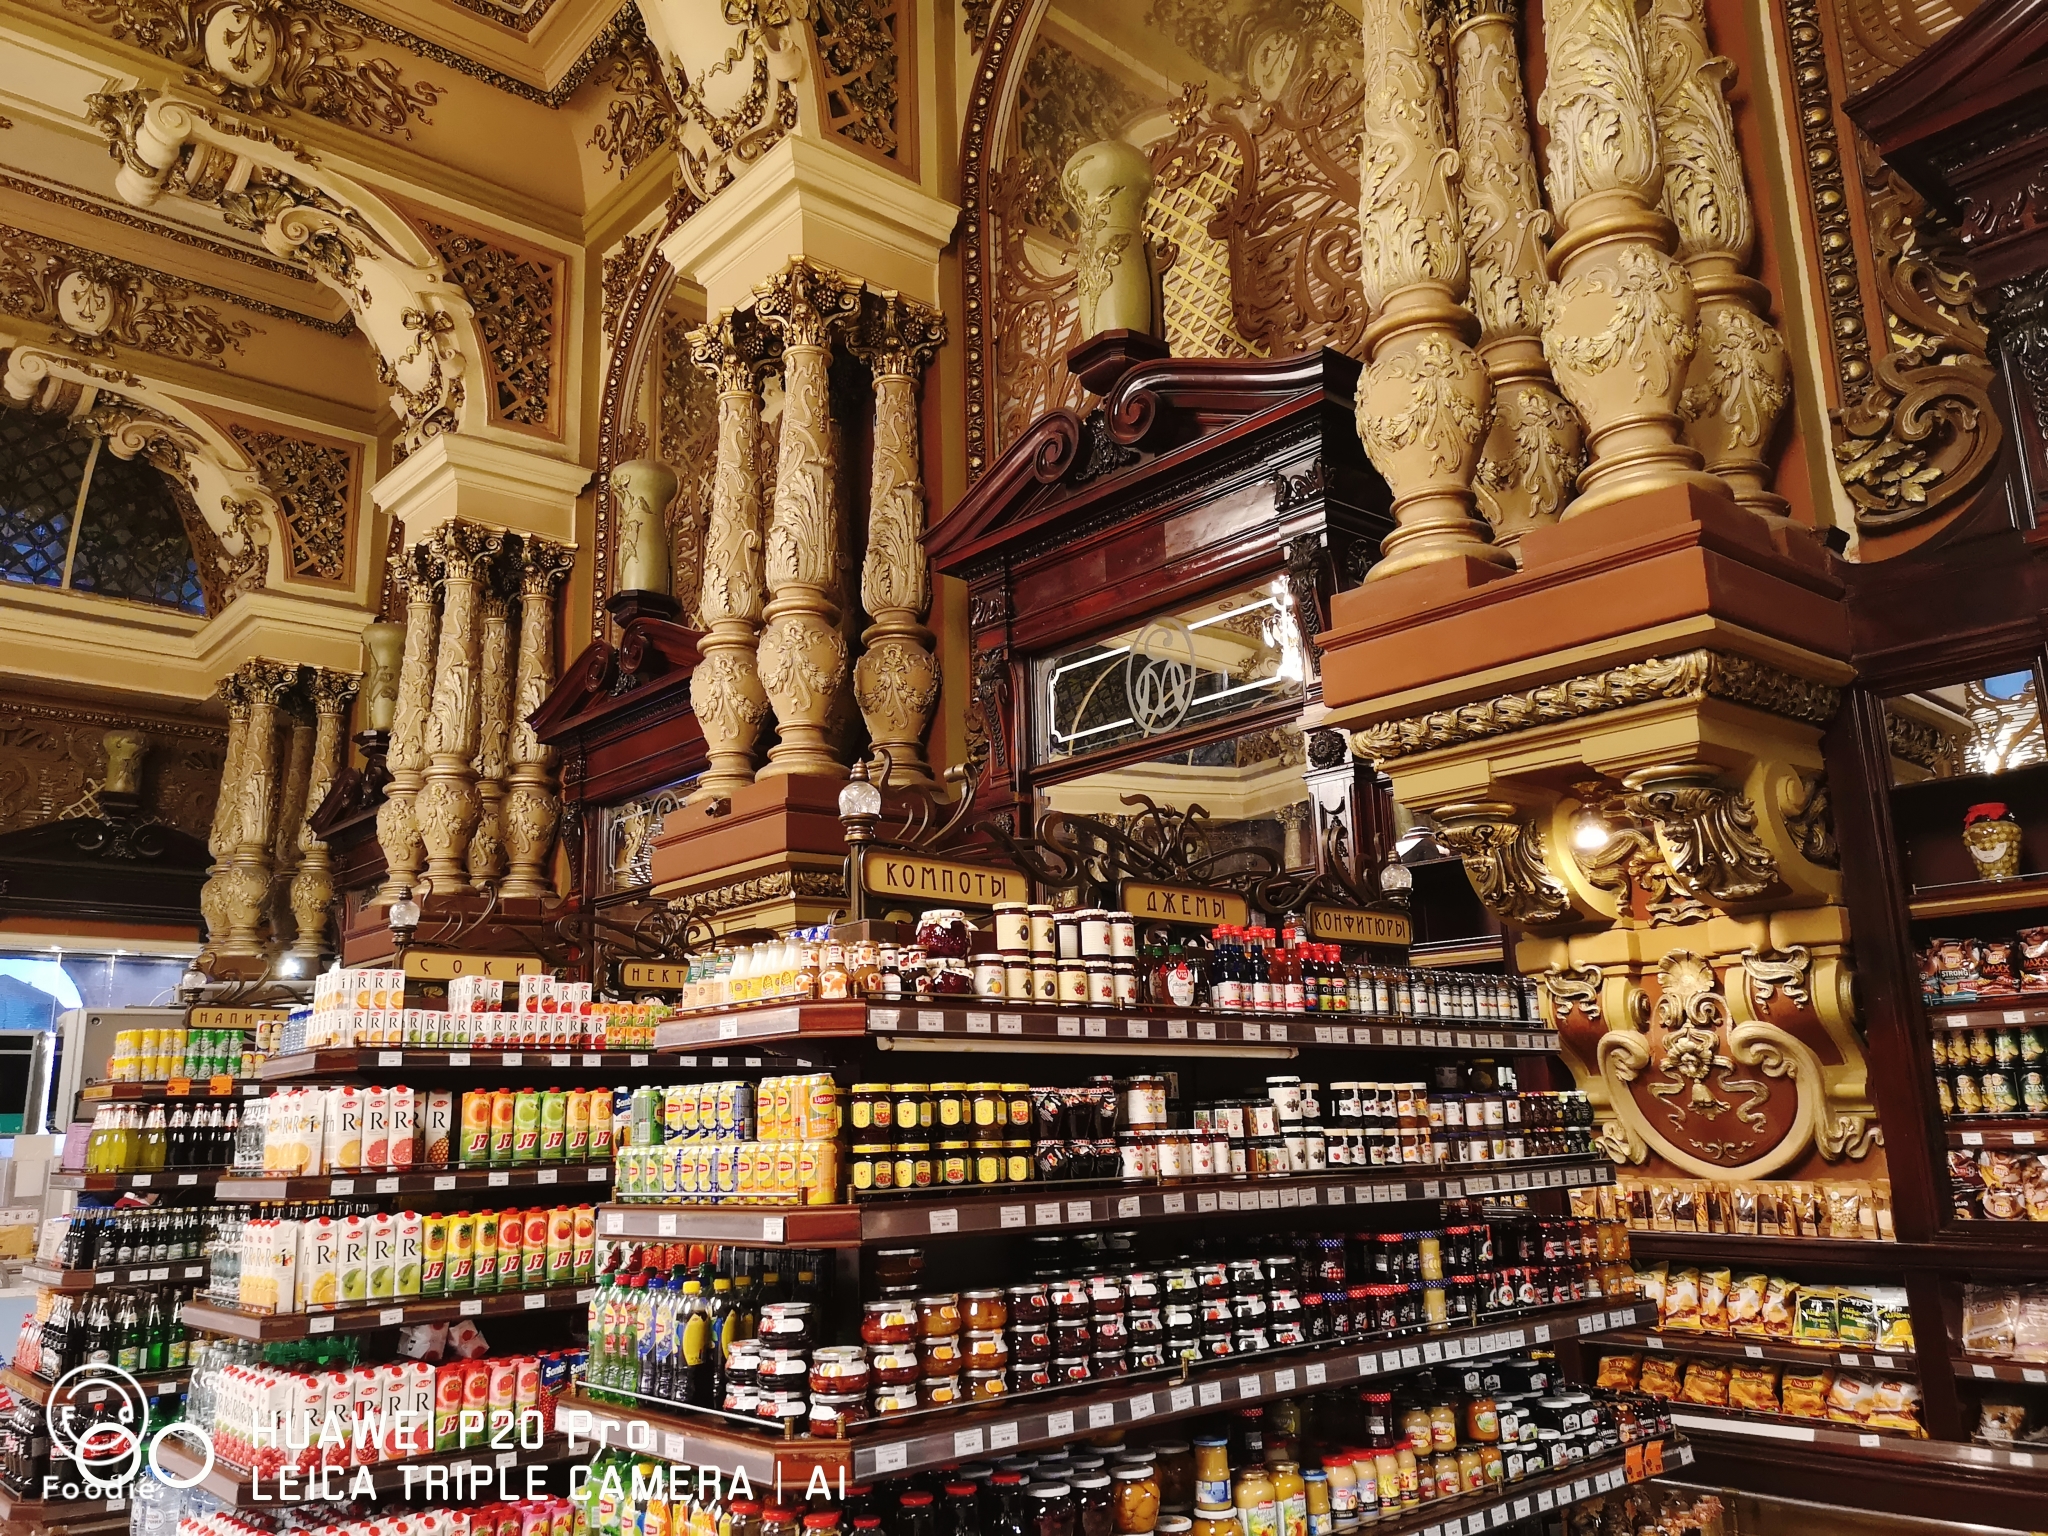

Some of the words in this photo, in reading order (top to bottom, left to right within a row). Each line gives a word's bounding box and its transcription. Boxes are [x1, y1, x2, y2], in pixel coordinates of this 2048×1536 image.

[886, 862, 1007, 899] КОМПОТЫ
[1147, 891, 1226, 919] ДЖЕМЫ
[1313, 911, 1406, 938] КОНФИТЮРЫ
[420, 958, 524, 976] СОКИ
[632, 968, 683, 983] НЕКТ
[358, 977, 367, 989] R
[375, 977, 384, 989] R
[391, 977, 400, 989] R
[474, 983, 482, 994] R
[527, 982, 536, 993] R
[542, 982, 551, 994] R
[490, 987, 499, 998] R
[562, 990, 569, 1001] R
[581, 989, 590, 1000] R
[200, 1012, 281, 1024] НАПИТК
[354, 1017, 363, 1028] R
[371, 1017, 380, 1028] R
[389, 1017, 398, 1028] R
[410, 1017, 418, 1028] R
[426, 1018, 435, 1030] R
[443, 1019, 451, 1030] R
[457, 1019, 467, 1030] R
[474, 1020, 483, 1031] R
[494, 1019, 502, 1030] R
[509, 1019, 518, 1030] R
[524, 1020, 533, 1031] R
[540, 1020, 548, 1031] R
[555, 1021, 563, 1032] R
[570, 1020, 578, 1031] R
[581, 1022, 589, 1033] R
[595, 1022, 603, 1033] R
[2025, 1084, 2045, 1092] STAX
[342, 1113, 357, 1131] R
[370, 1112, 385, 1130] R
[395, 1111, 409, 1129] R
[432, 1111, 446, 1129] R
[347, 1243, 362, 1263] R
[376, 1240, 390, 1260] R
[403, 1238, 417, 1257] R
[317, 1245, 332, 1265] R
[389, 1396, 401, 1416] R
[416, 1392, 430, 1412] R
[440, 1415, 458, 1435] J7
